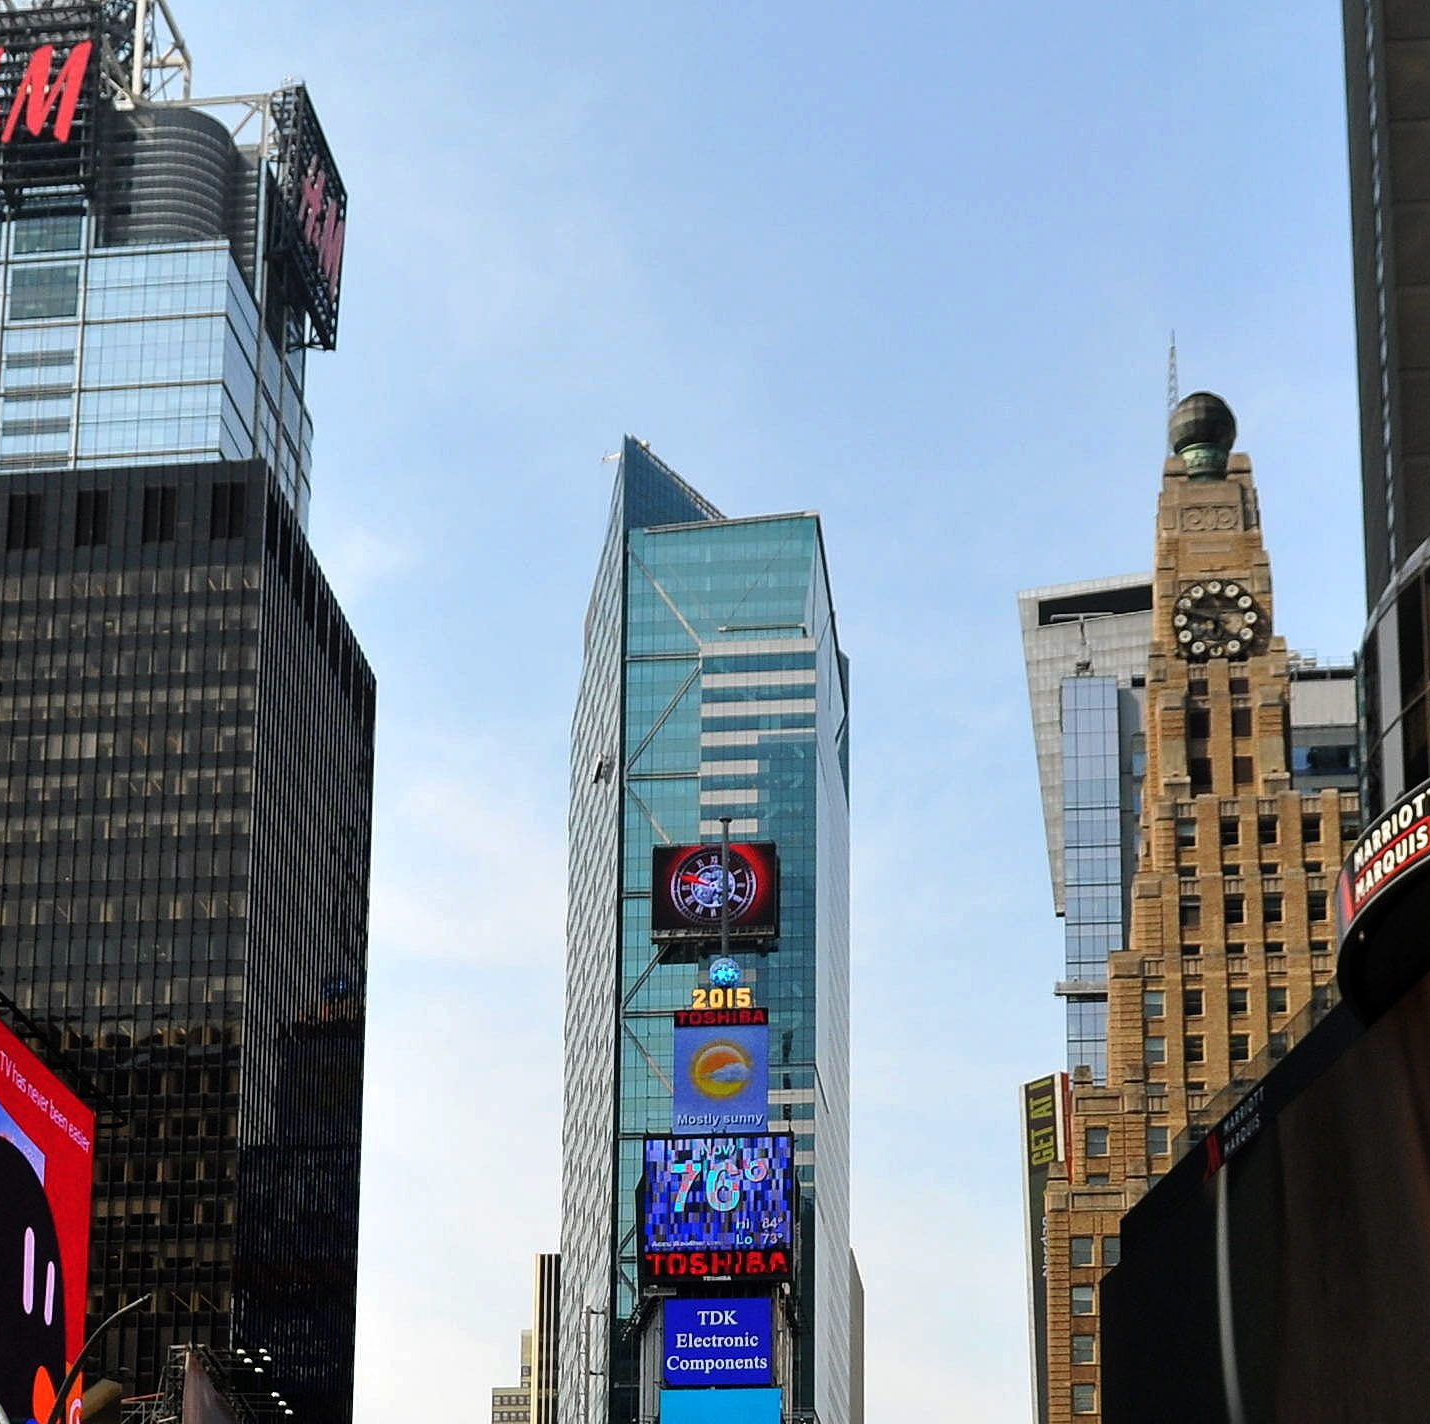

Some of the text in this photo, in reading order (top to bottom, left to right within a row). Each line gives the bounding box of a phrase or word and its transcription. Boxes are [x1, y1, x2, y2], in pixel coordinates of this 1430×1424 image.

[1355, 825, 1428, 903] MARQUIS
[692, 987, 753, 1009] 2015
[676, 1010, 768, 1025] TOSHIBA
[0, 1050, 11, 1078] TV
[12, 1064, 26, 1093] has
[27, 1085, 49, 1113] never
[50, 1099, 67, 1132] been
[69, 1123, 90, 1152] easier
[677, 1112, 763, 1129] Mostly sunny
[1030, 1094, 1054, 1166] GET AT
[702, 1143, 736, 1156] Now
[671, 1158, 768, 1213] 76°
[736, 1233, 753, 1245] Lo
[645, 1250, 788, 1276] TOSHIBA
[697, 1310, 739, 1326] TDK
[676, 1333, 759, 1349] Electronic
[666, 1355, 768, 1373] Components
